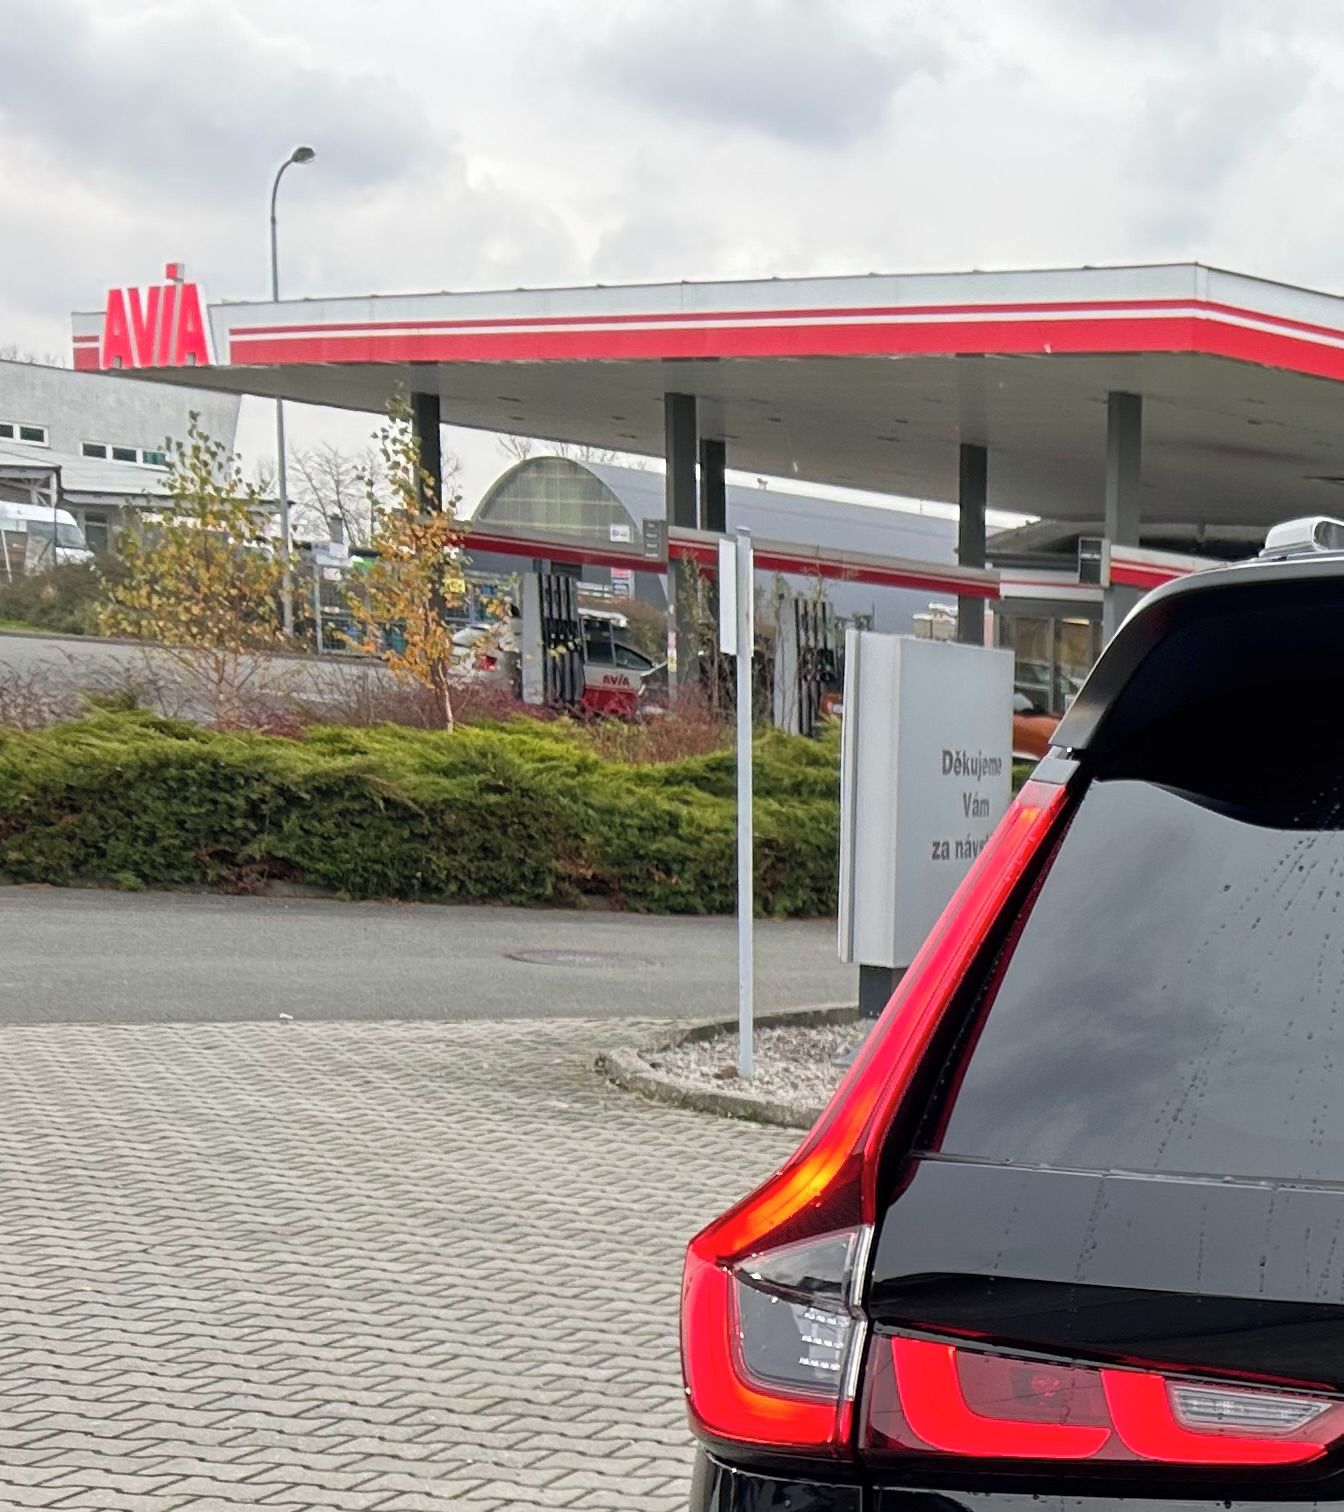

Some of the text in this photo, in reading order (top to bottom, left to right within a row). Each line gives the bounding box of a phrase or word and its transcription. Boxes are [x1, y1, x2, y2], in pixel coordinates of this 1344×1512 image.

[942, 750, 1002, 781] Děkujeme
[963, 792, 989, 818] Vám
[932, 841, 950, 860] za
